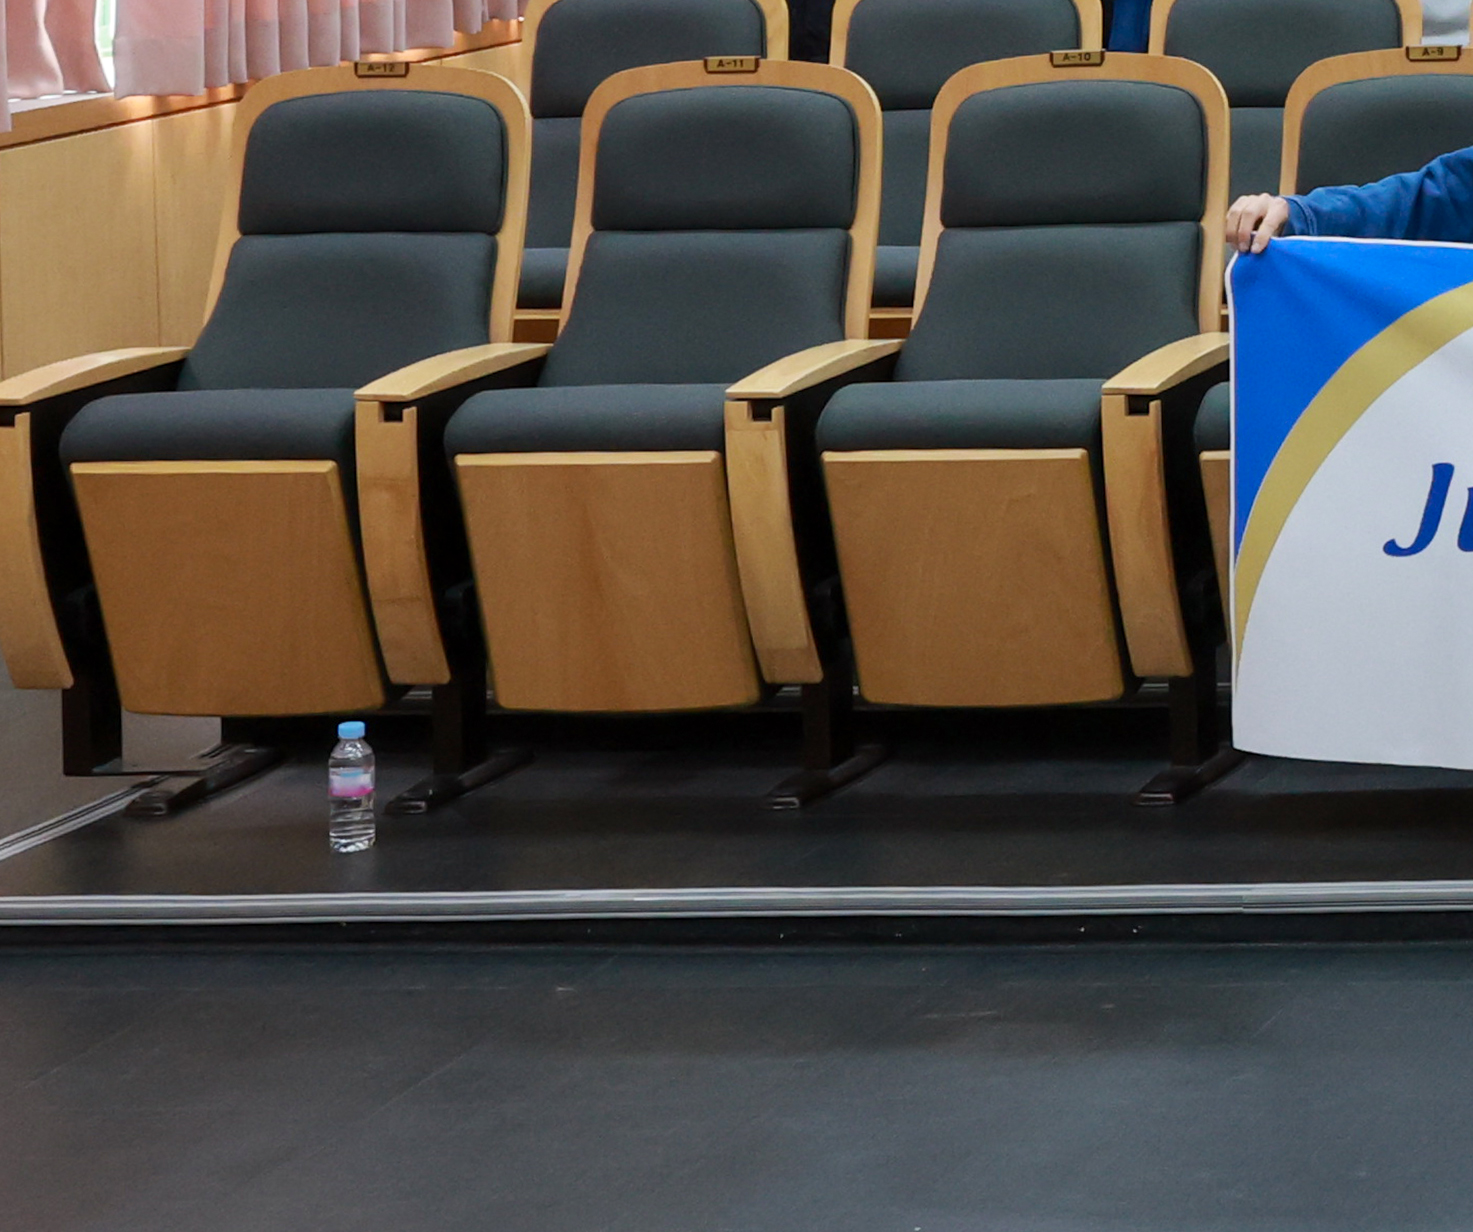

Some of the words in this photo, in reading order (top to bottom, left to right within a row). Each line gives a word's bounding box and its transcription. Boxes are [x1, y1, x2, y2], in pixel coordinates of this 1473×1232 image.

[1062, 52, 1092, 62] A-10
[1421, 47, 1445, 58] A-9
[367, 62, 396, 73] A-12
[716, 59, 745, 69] A-11
